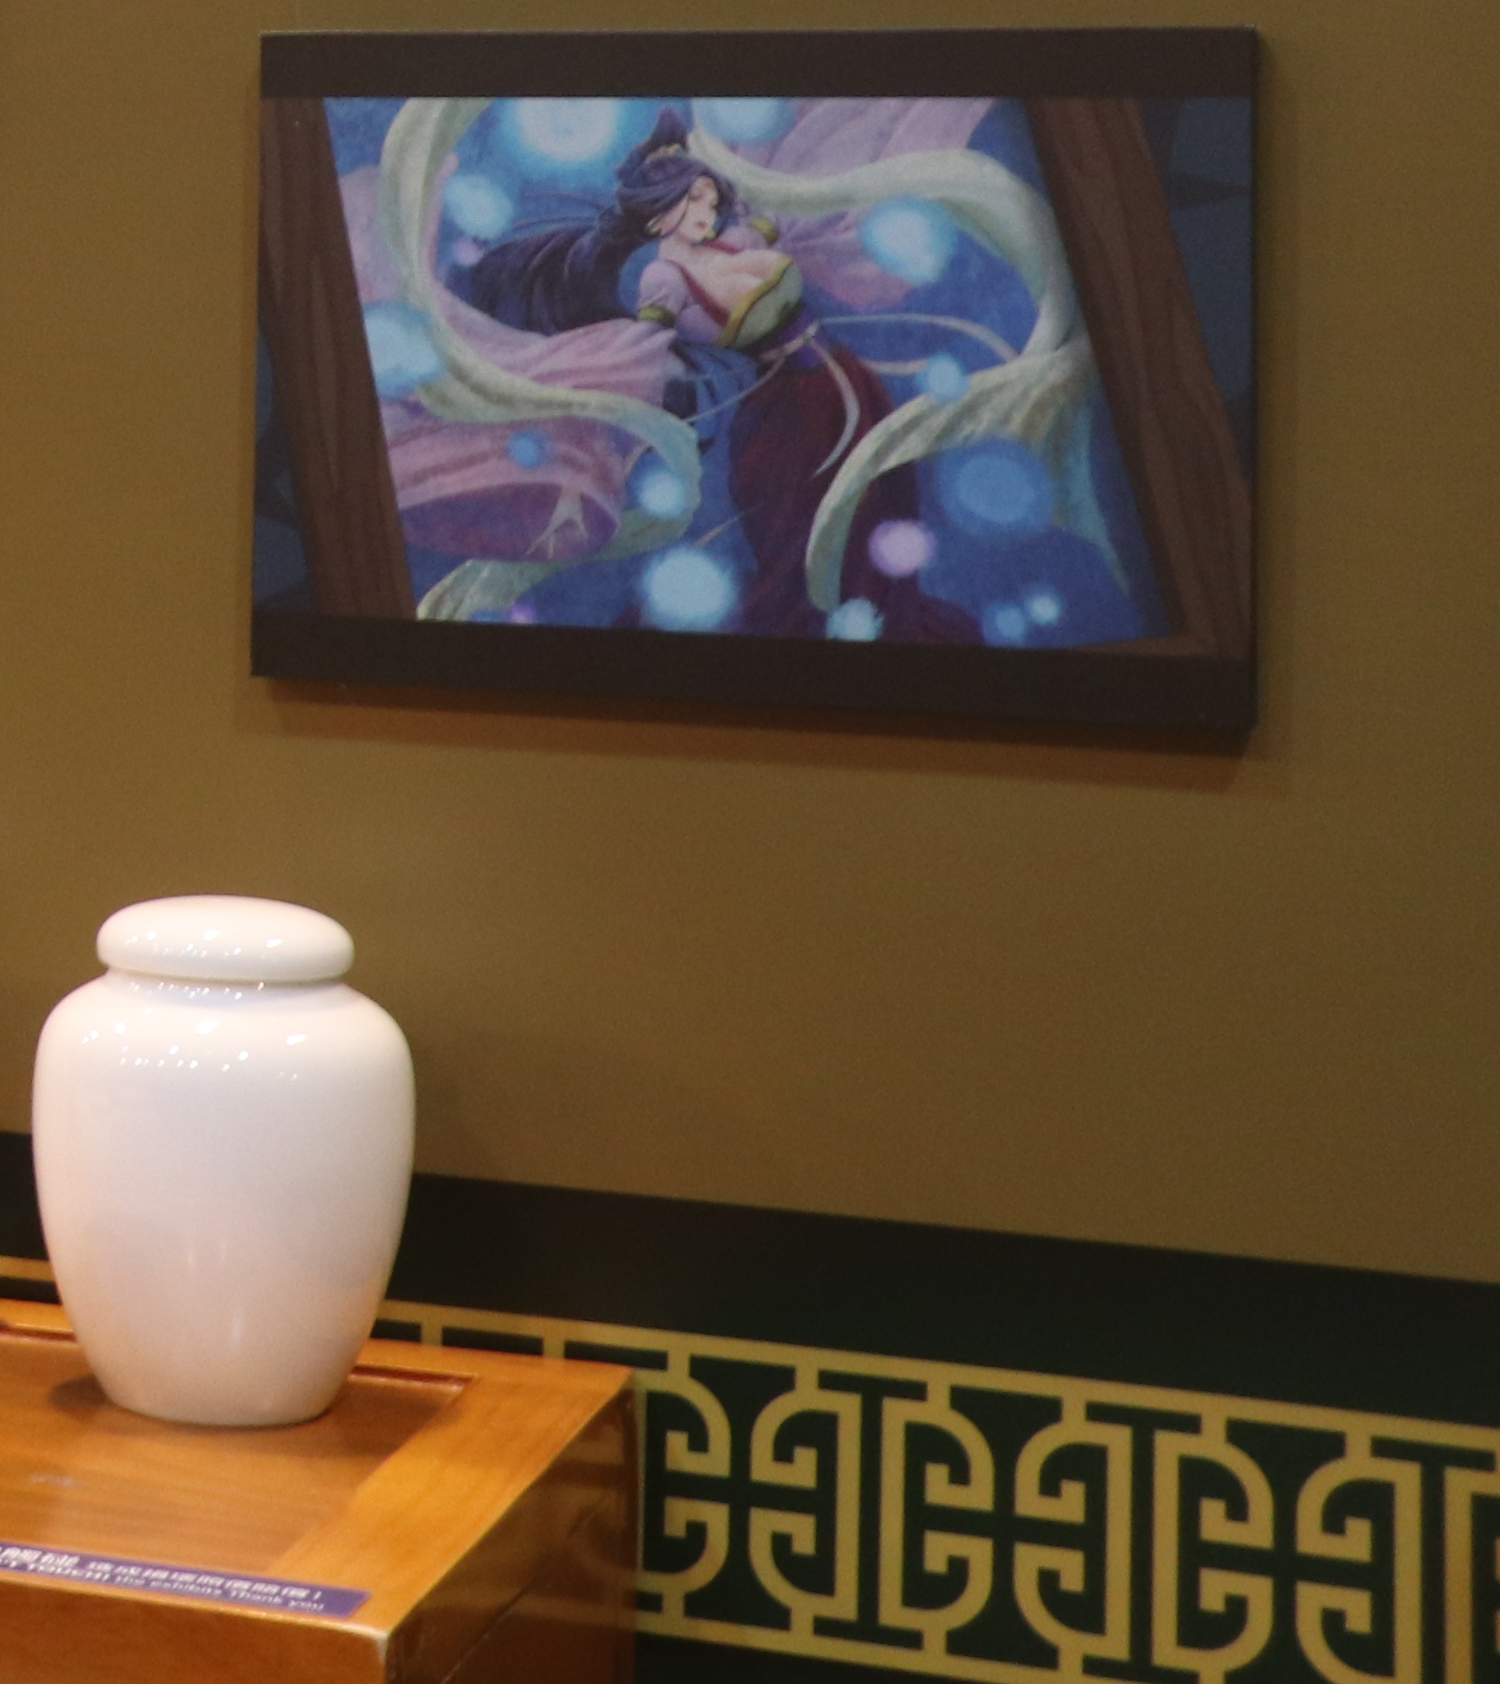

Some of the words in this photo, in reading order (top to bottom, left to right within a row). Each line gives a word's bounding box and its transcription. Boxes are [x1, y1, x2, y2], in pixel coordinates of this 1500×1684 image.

[26, 1563, 111, 1583] TOUCH!
[112, 1574, 146, 1587] the
[229, 1588, 284, 1605] Thank
[286, 1599, 325, 1612] you
